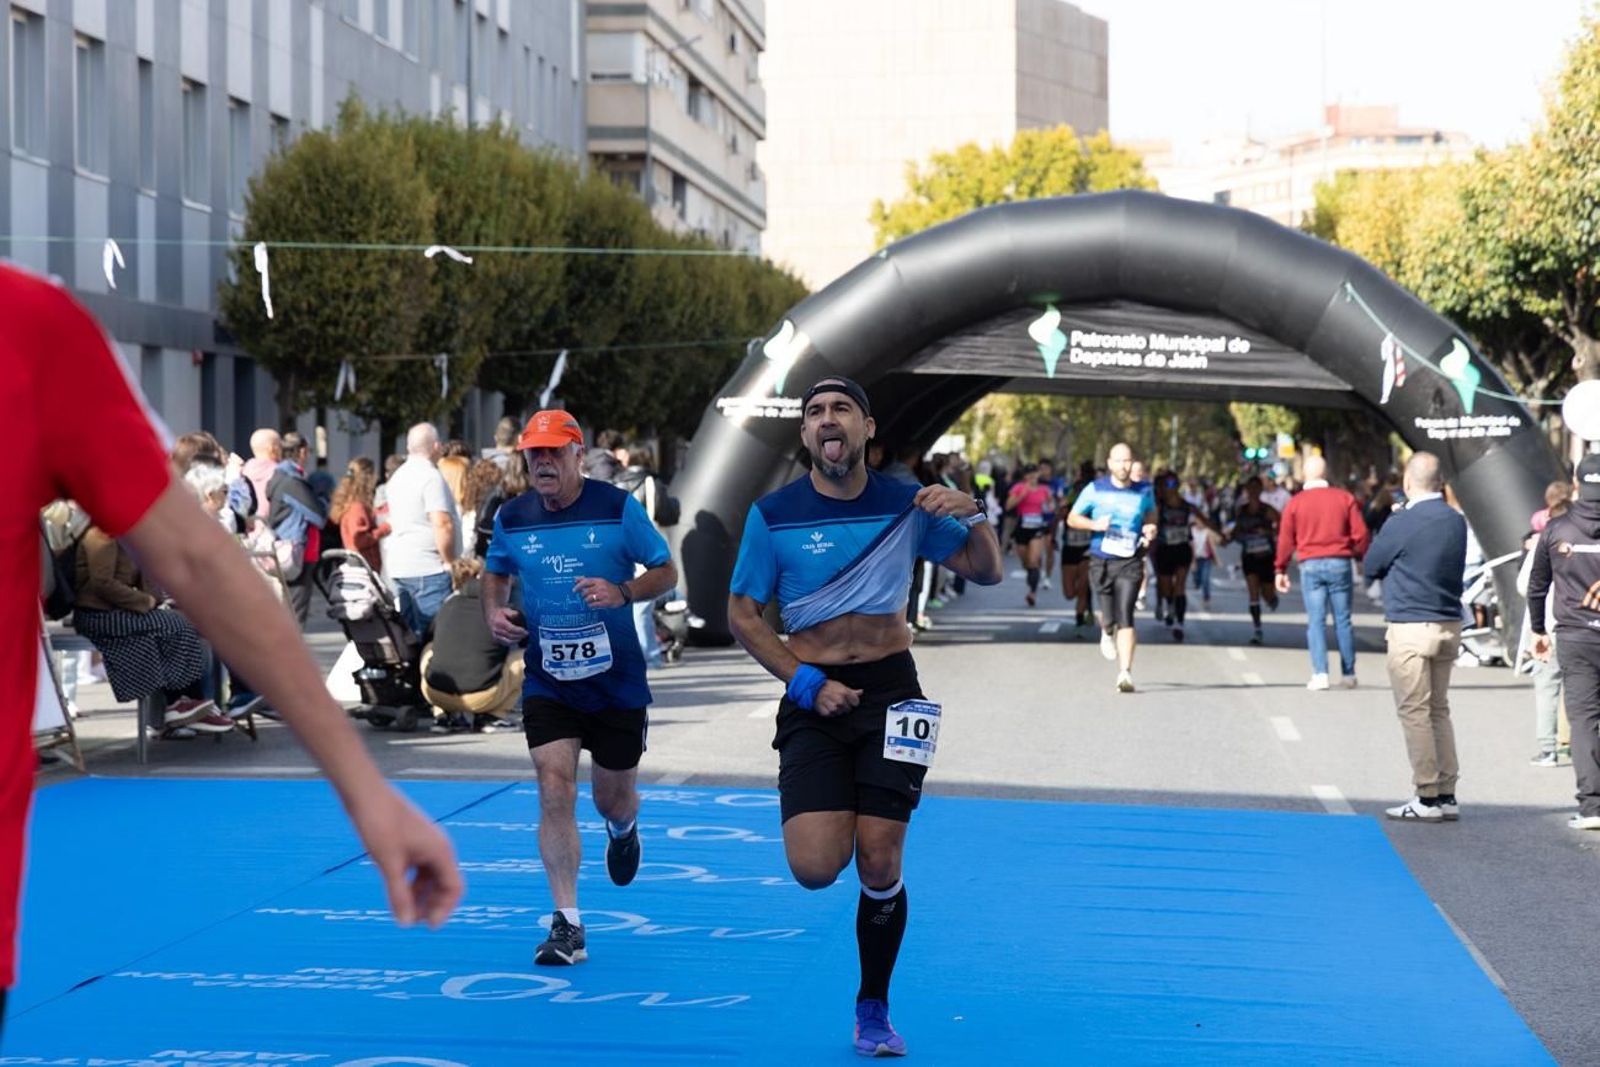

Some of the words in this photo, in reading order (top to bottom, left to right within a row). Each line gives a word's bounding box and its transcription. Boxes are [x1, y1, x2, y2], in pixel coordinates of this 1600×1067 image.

[1070, 330, 1147, 350] Patronato
[1149, 333, 1226, 355] Municipal
[1228, 336, 1251, 353] de
[1070, 347, 1142, 368] Deportes
[1144, 351, 1167, 368] de
[1168, 352, 1208, 369] Jaén
[551, 641, 596, 661] 578
